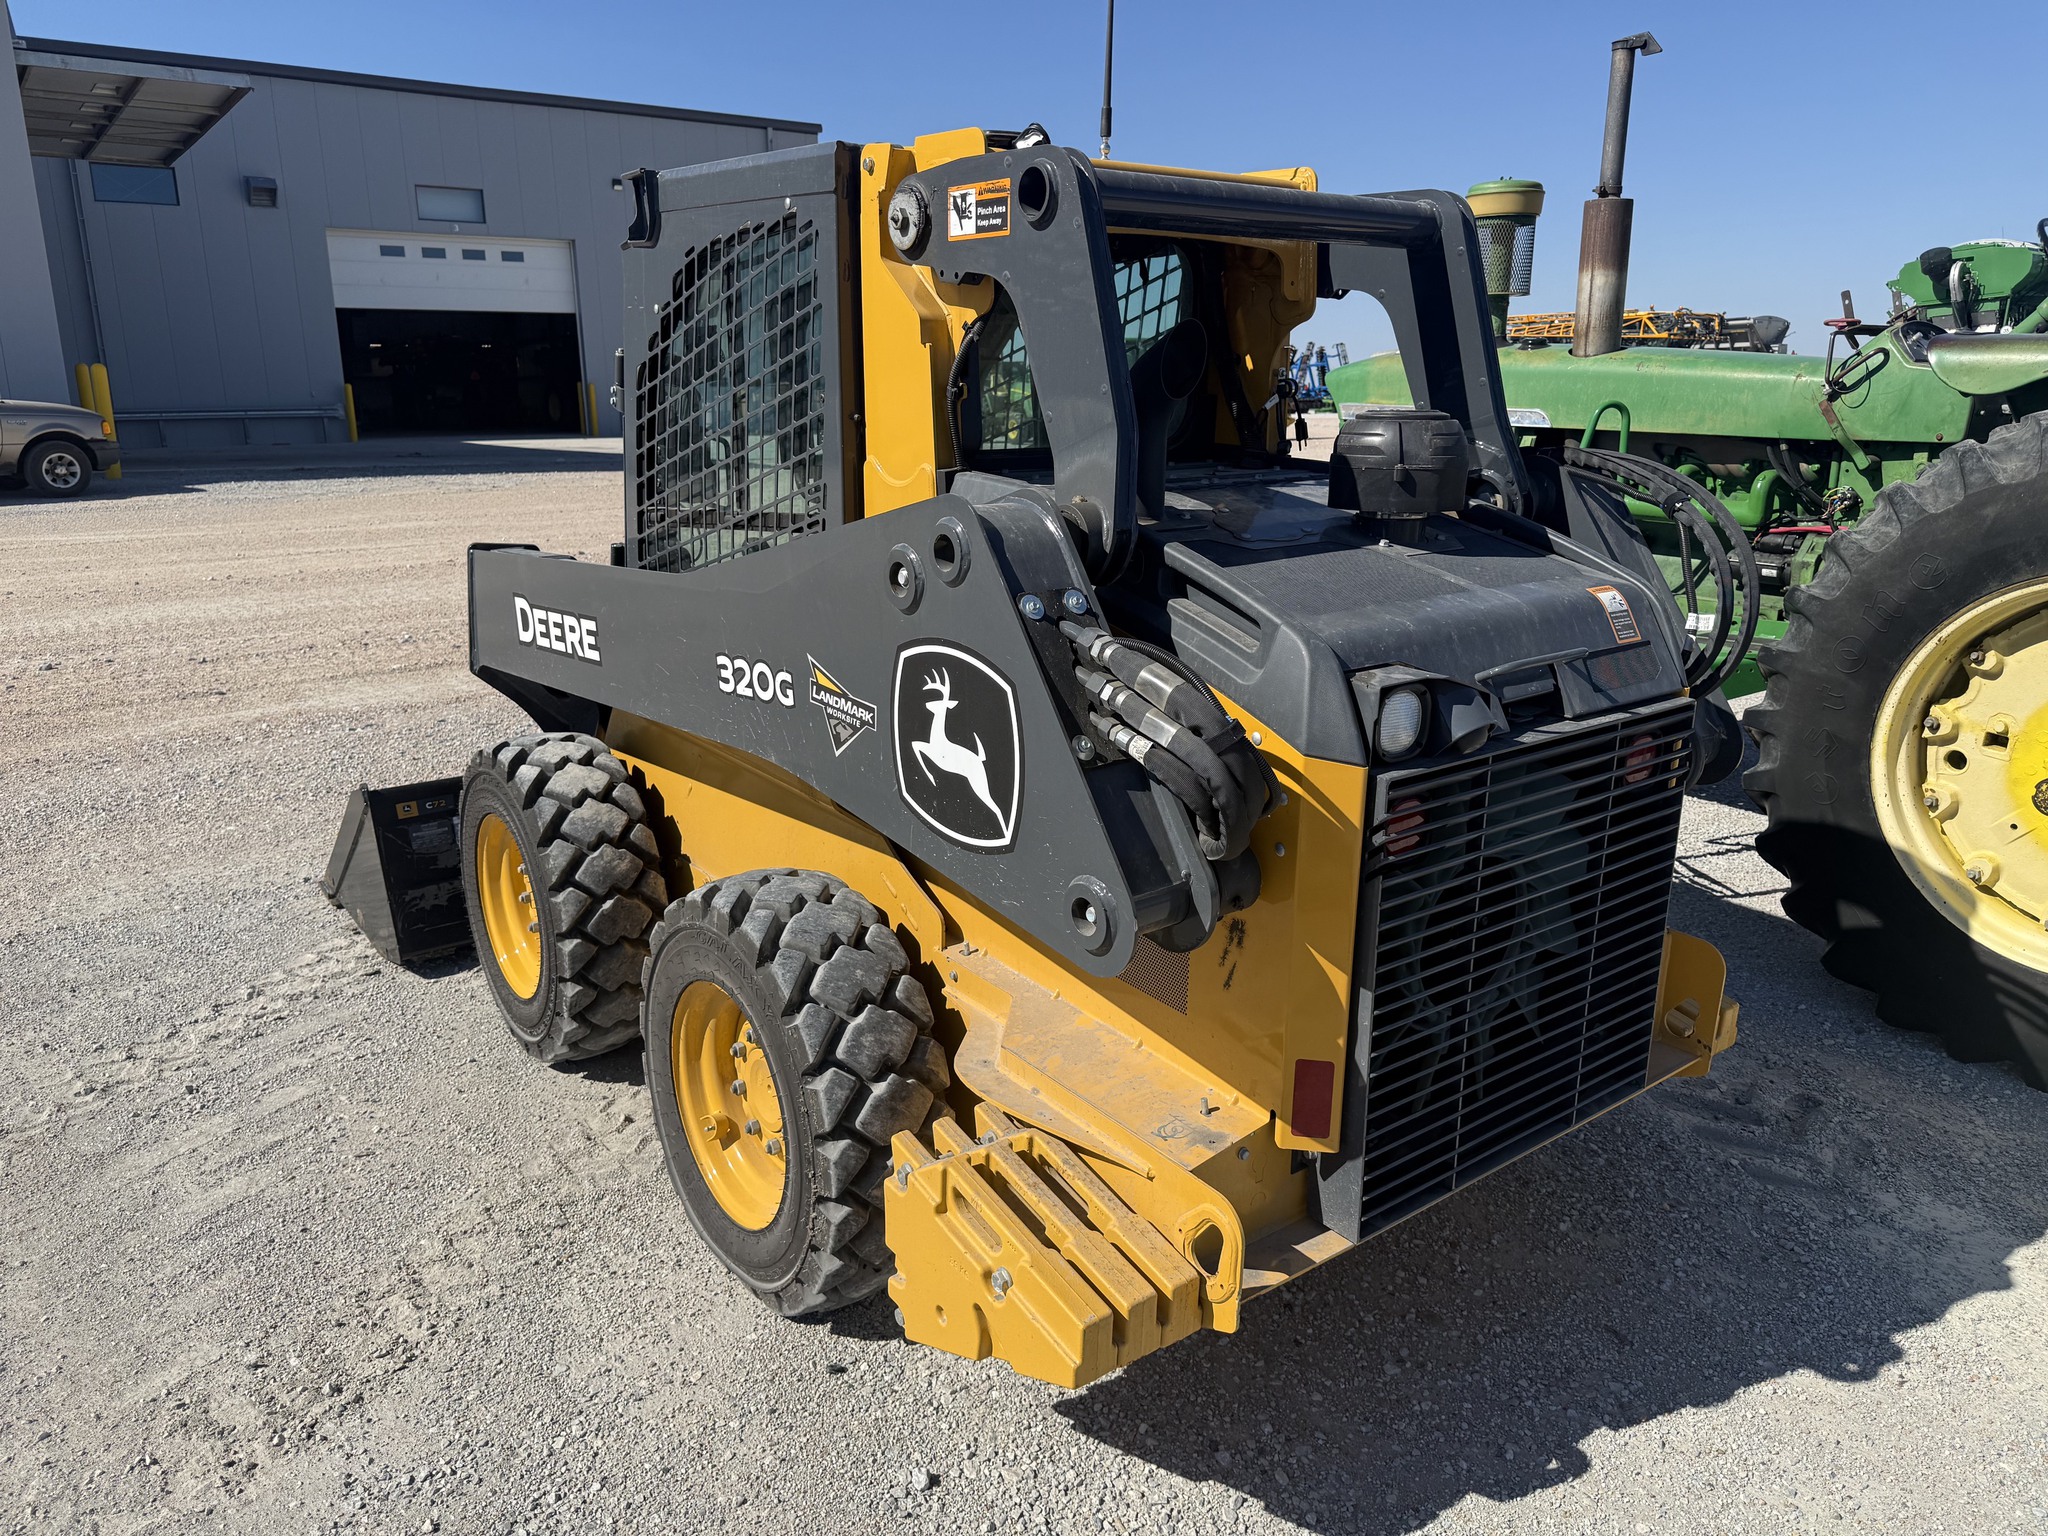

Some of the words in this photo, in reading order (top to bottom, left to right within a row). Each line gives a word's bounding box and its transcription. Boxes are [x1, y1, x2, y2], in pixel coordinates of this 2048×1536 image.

[977, 206, 992, 215] Pinch
[993, 204, 1006, 214] Area
[977, 218, 989, 227] Keep
[990, 217, 1002, 226] Away
[514, 596, 601, 662] DEERE
[716, 655, 795, 706] 320G
[812, 685, 874, 725] LANDMARK
[826, 705, 861, 728] WORKSITE
[425, 800, 446, 809] C72
